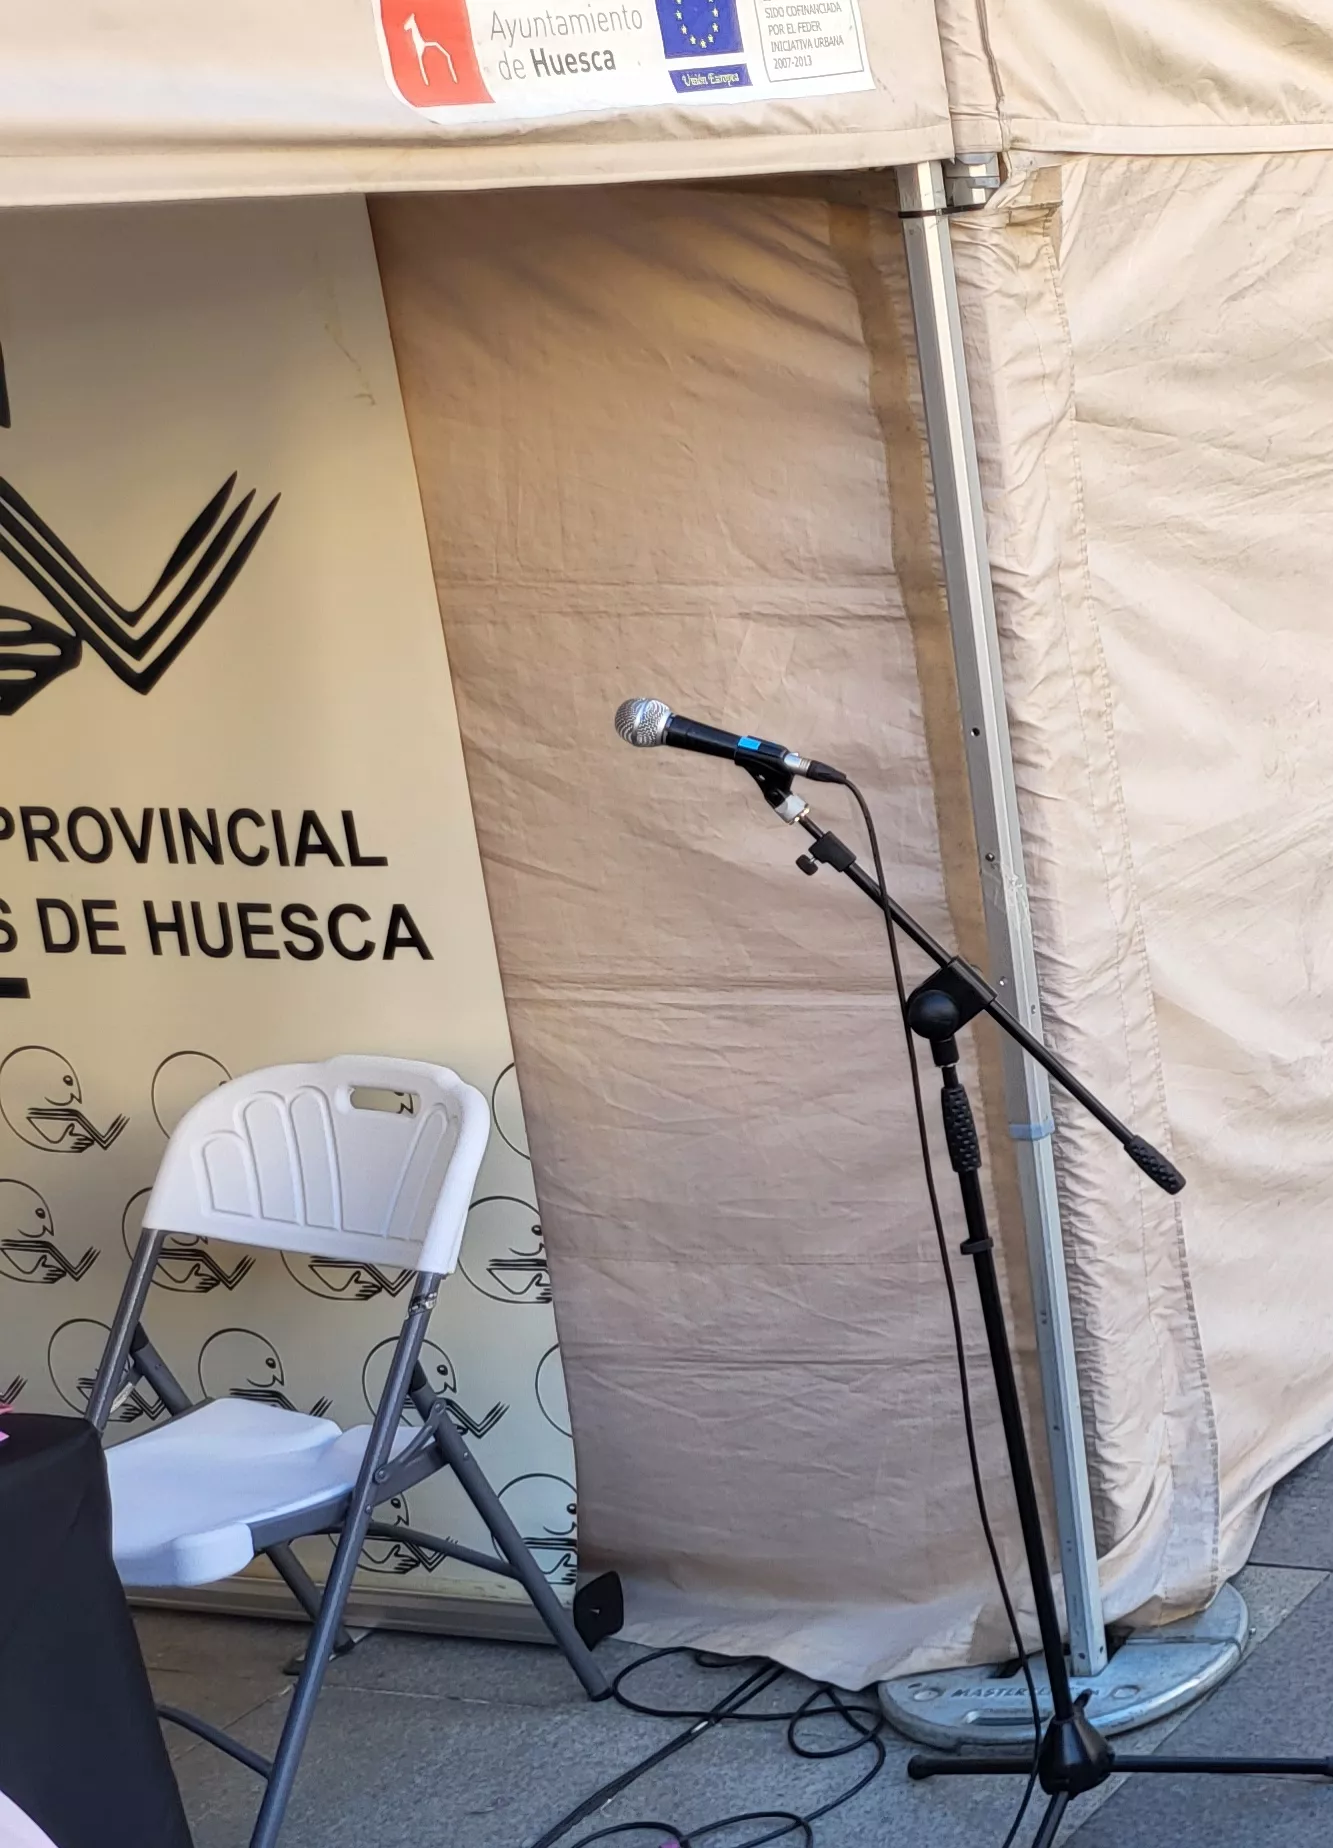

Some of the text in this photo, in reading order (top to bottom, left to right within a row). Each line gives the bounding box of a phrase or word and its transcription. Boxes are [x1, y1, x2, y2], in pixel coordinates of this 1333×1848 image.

[765, 2, 843, 18] SIDO COFINANCIADA
[490, 4, 643, 50] Ayuntamiento
[768, 22, 822, 36] POR EL FEDER
[770, 35, 844, 52] INICIATIVA URBANA
[498, 48, 617, 81] de Huesca
[773, 55, 813, 69] 2007-2013
[36, 897, 127, 955] DE
[143, 899, 435, 962] HUESCA
